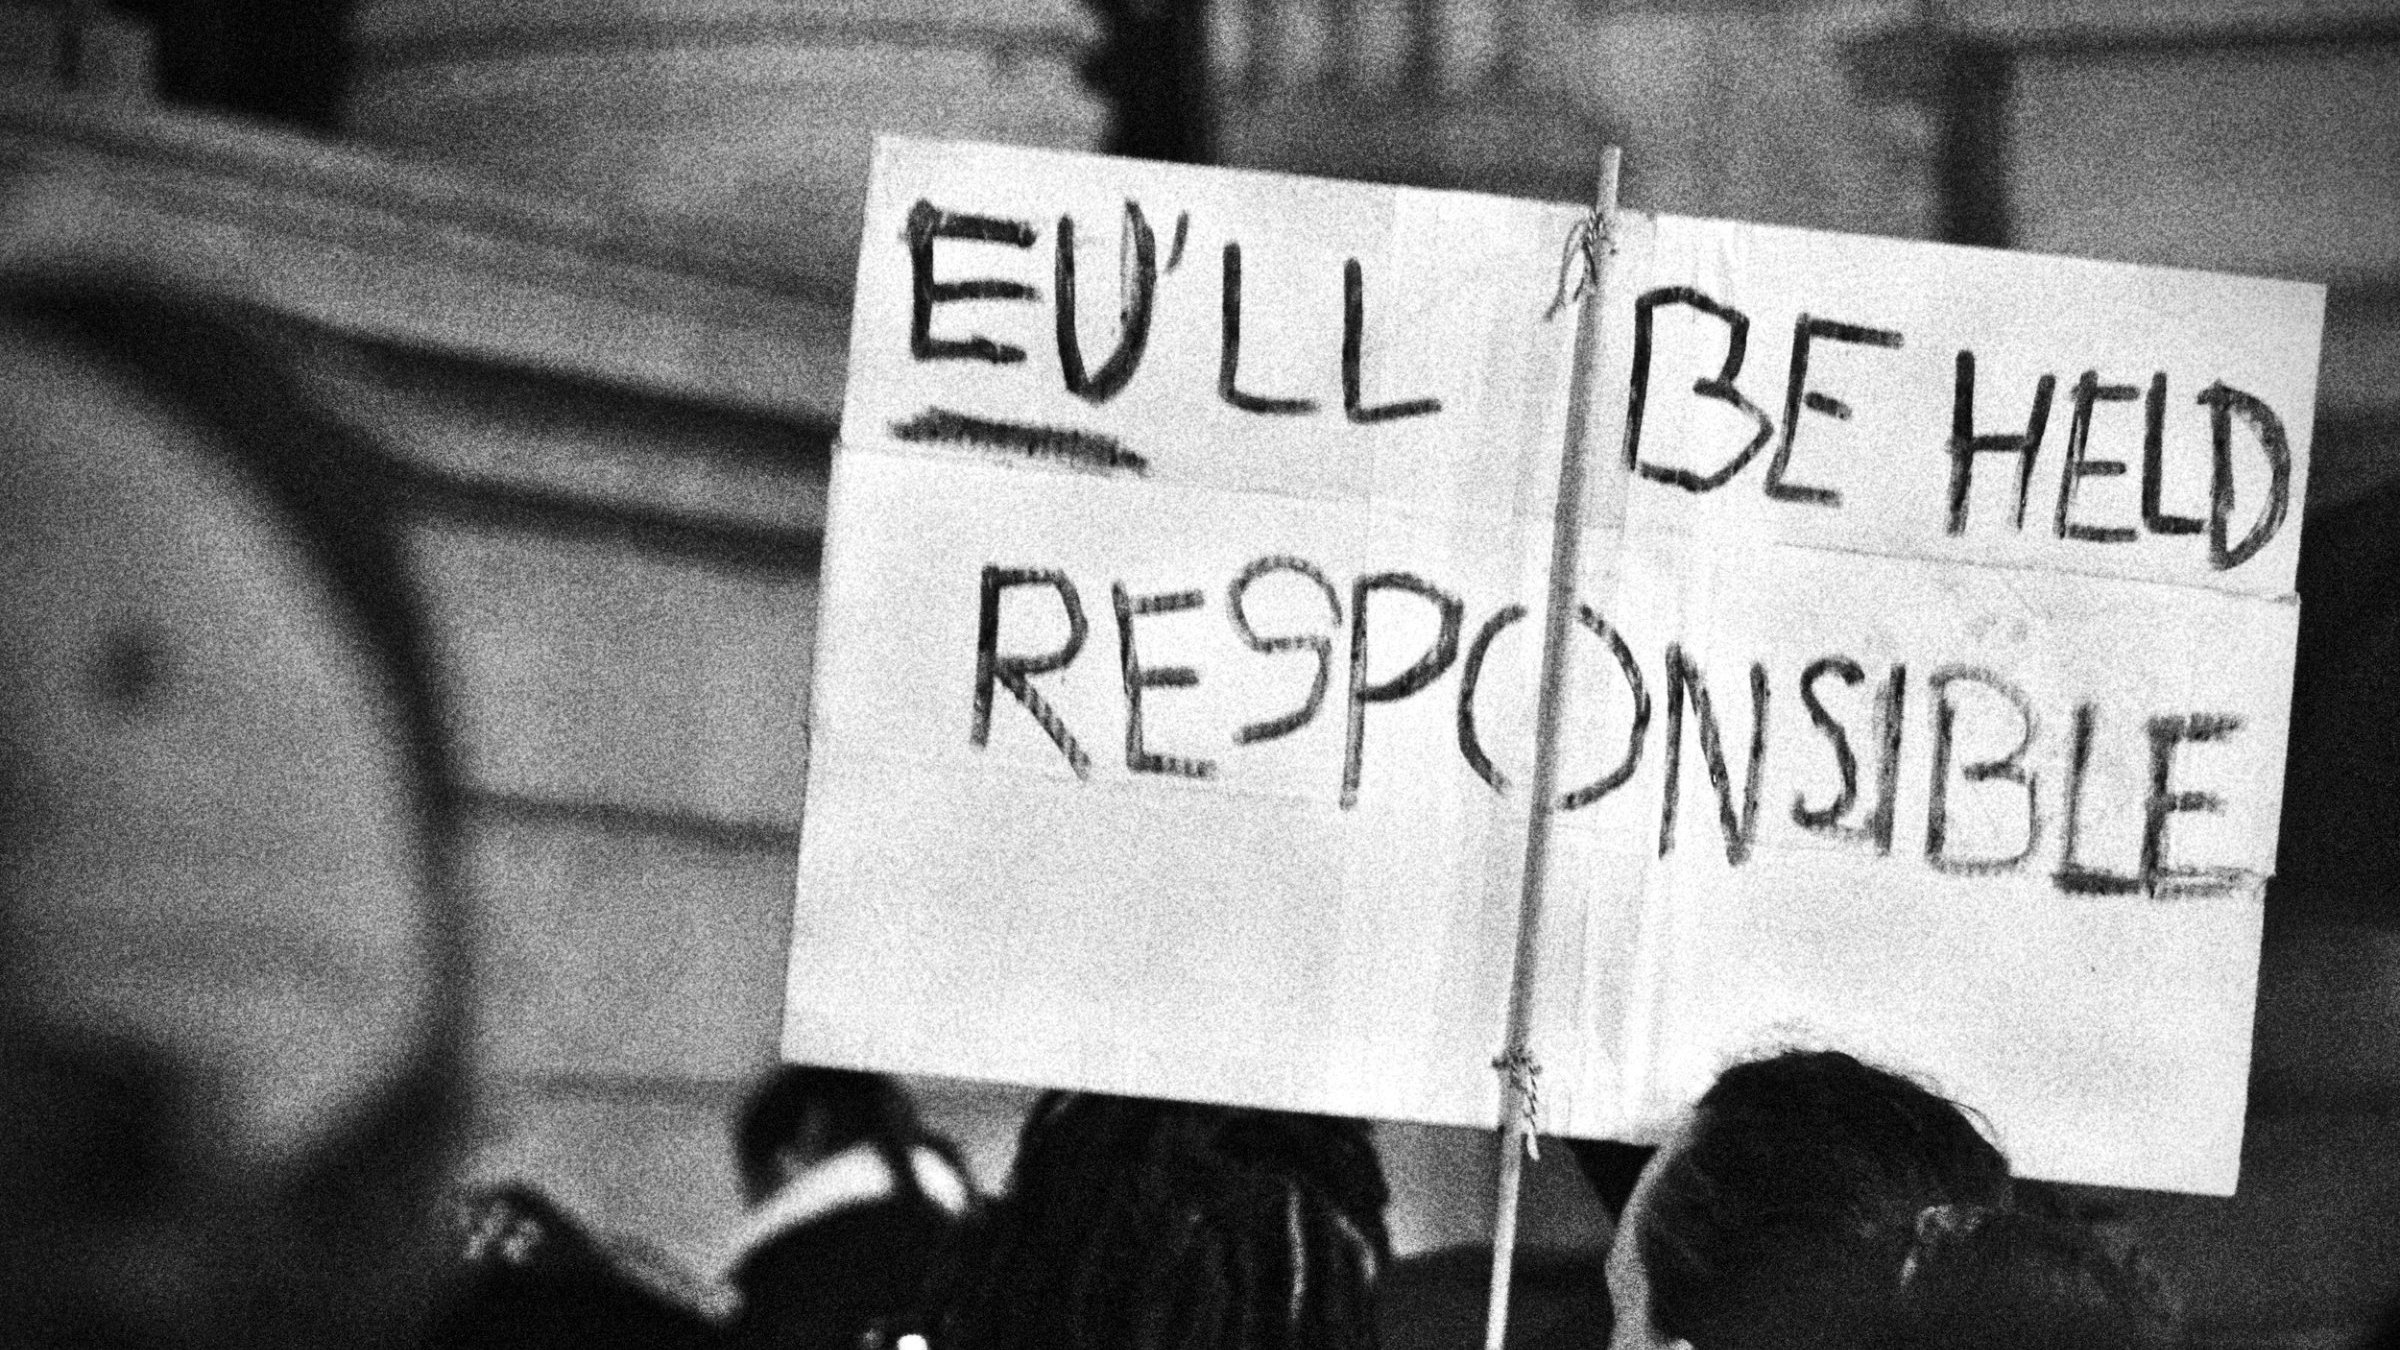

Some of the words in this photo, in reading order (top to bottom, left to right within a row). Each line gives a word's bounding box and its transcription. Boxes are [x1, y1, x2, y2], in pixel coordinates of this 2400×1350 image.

[905, 198, 1442, 424] EU'LL
[1623, 284, 1904, 506] BE
[1945, 349, 2292, 571] HELD
[970, 554, 2264, 899] RESPONSIBLE
